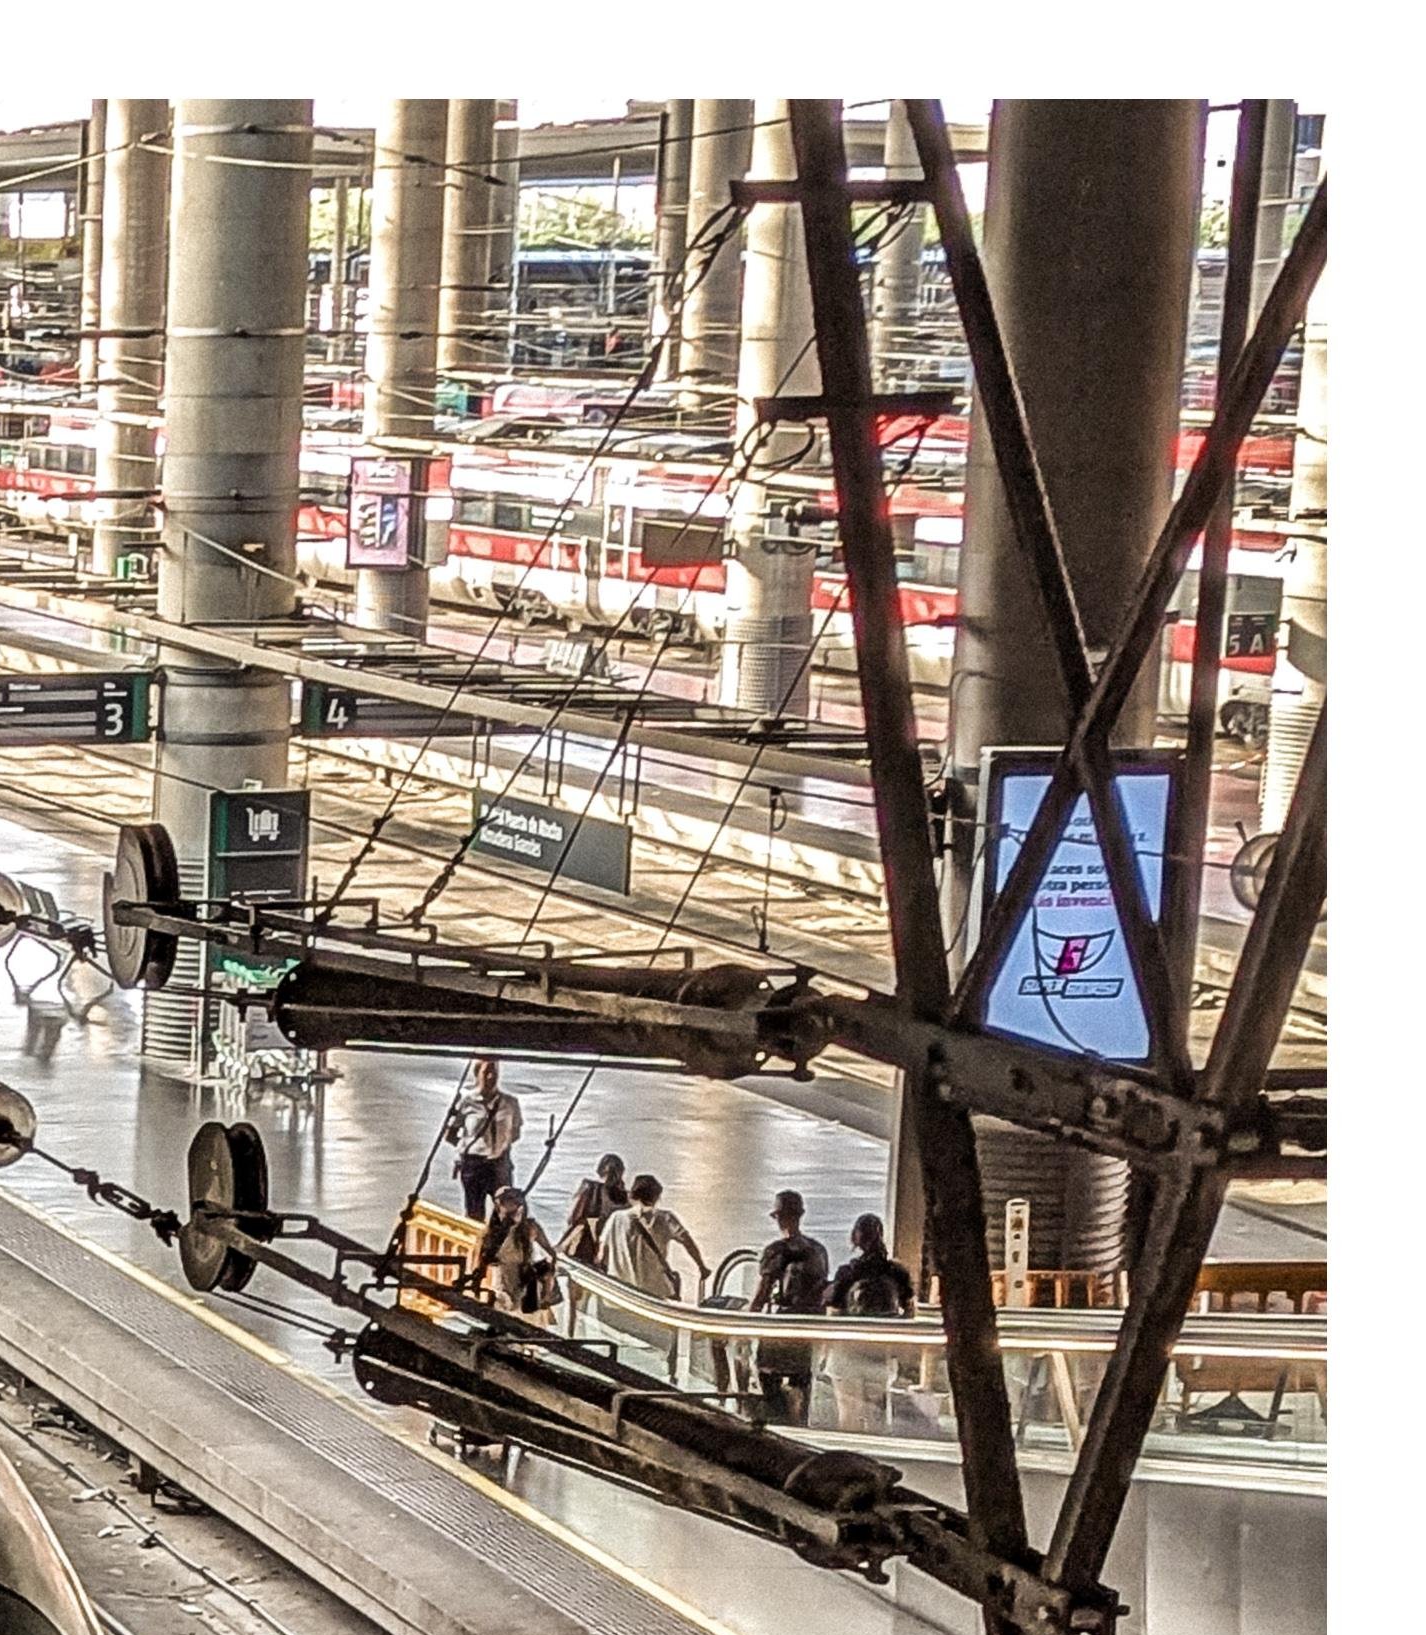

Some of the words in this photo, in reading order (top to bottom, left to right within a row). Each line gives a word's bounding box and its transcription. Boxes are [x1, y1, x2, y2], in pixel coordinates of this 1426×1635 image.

[1228, 634, 1241, 656] 5
[1249, 633, 1265, 655] A
[104, 703, 124, 736] 3
[326, 698, 349, 731] 4
